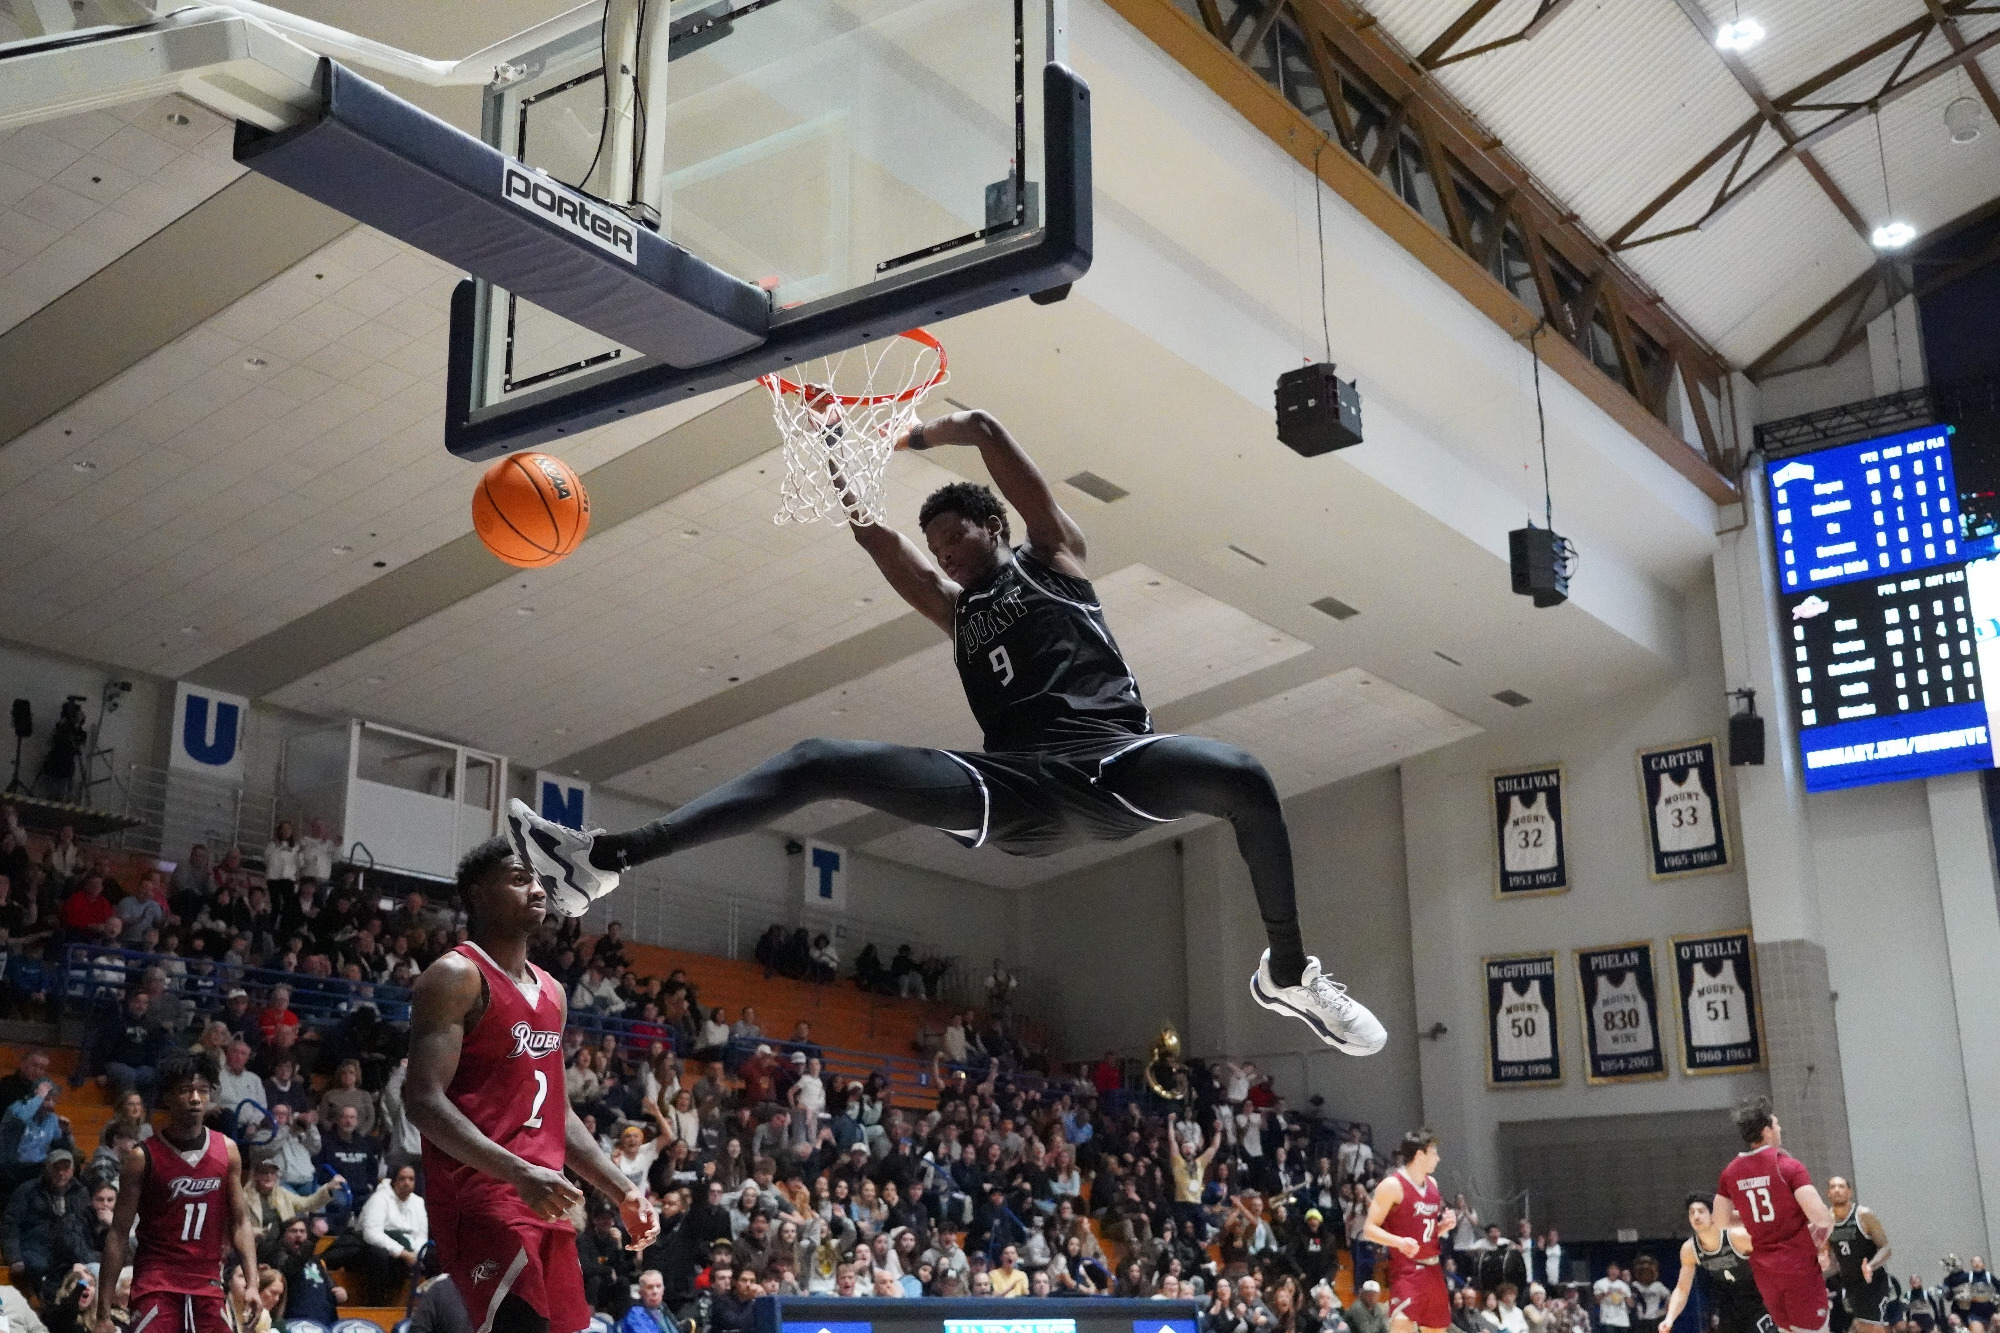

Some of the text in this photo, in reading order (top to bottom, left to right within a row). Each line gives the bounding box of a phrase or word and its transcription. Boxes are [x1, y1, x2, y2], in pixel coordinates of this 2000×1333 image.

[960, 586, 1028, 664] OUNT
[988, 644, 1015, 687] 9
[184, 694, 239, 766] U
[1651, 749, 1704, 771] CARTER
[1497, 773, 1558, 793] SULLIVAN
[542, 782, 584, 832] N
[1664, 791, 1700, 807] MOUNT
[1512, 814, 1546, 828] MOUNT
[1671, 805, 1699, 829] 33
[1518, 828, 1543, 849] 32
[812, 848, 840, 899] T
[1591, 951, 1640, 971] PHELAN
[1681, 940, 1742, 960] O'REILLY
[1489, 961, 1553, 980] McGUTHRIE
[1602, 993, 1638, 1008] MOUNT
[1697, 983, 1734, 999] MOUNT
[1506, 1003, 1540, 1016] MOUNT
[1603, 1008, 1640, 1032] 830
[1706, 999, 1730, 1021] 51
[1511, 1017, 1536, 1038] 50
[523, 1069, 548, 1129] 2
[168, 1176, 222, 1200] RIDER
[1746, 1187, 1775, 1223] 13
[181, 1202, 208, 1241] 11
